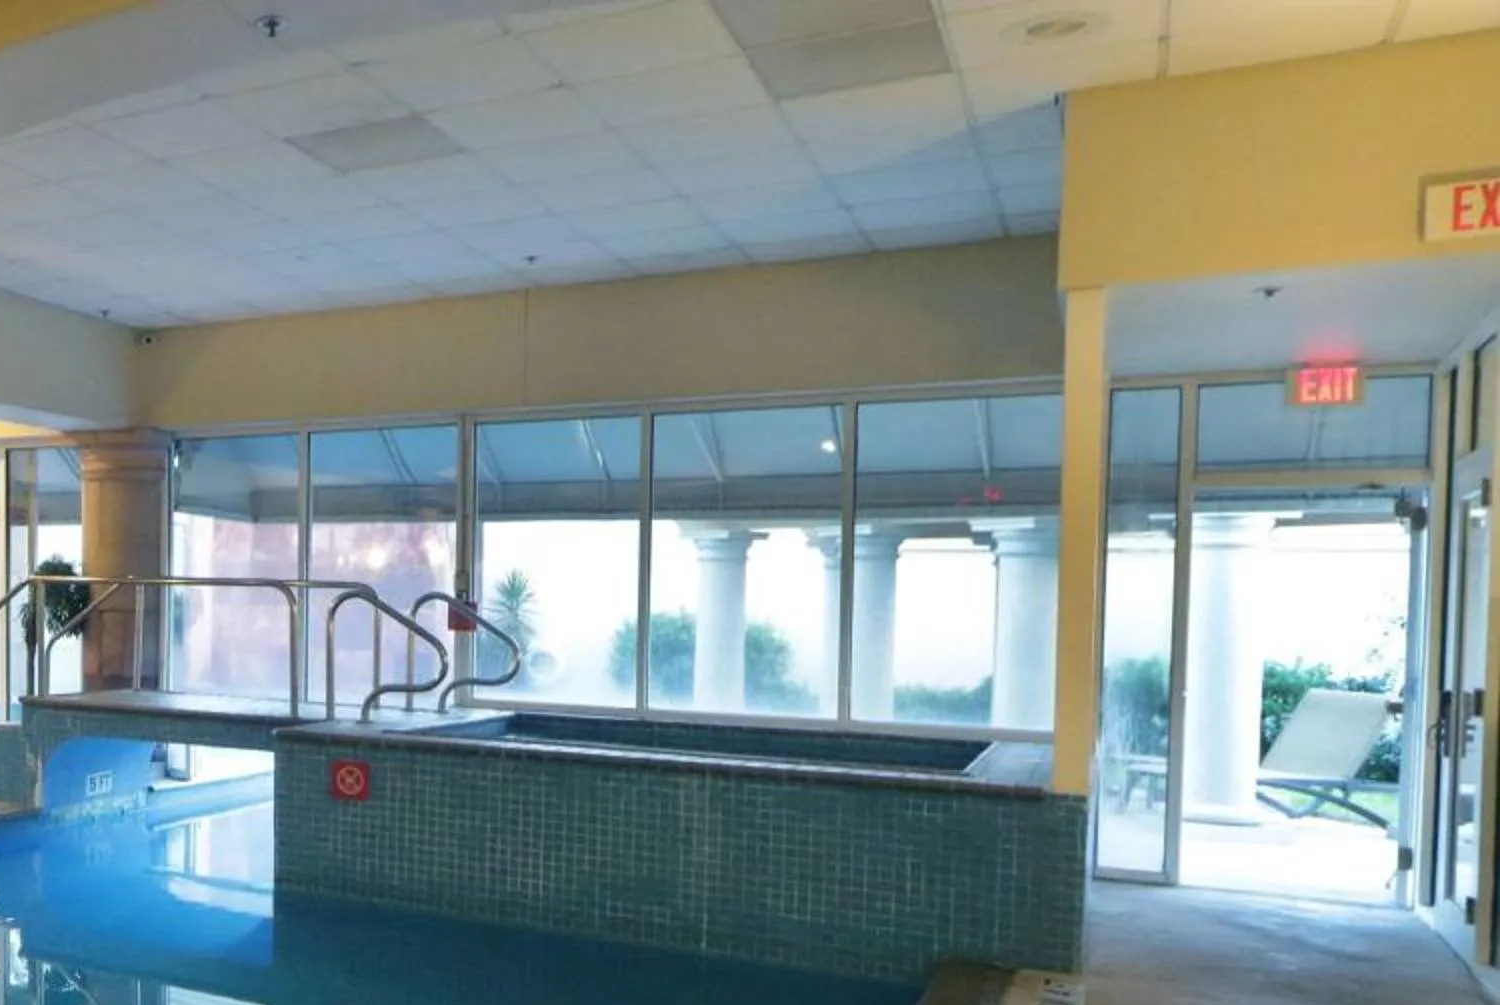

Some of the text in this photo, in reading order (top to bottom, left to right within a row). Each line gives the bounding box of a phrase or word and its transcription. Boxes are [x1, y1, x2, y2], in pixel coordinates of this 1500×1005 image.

[1299, 367, 1358, 403] EXIT
[89, 774, 110, 793] 5 FT
